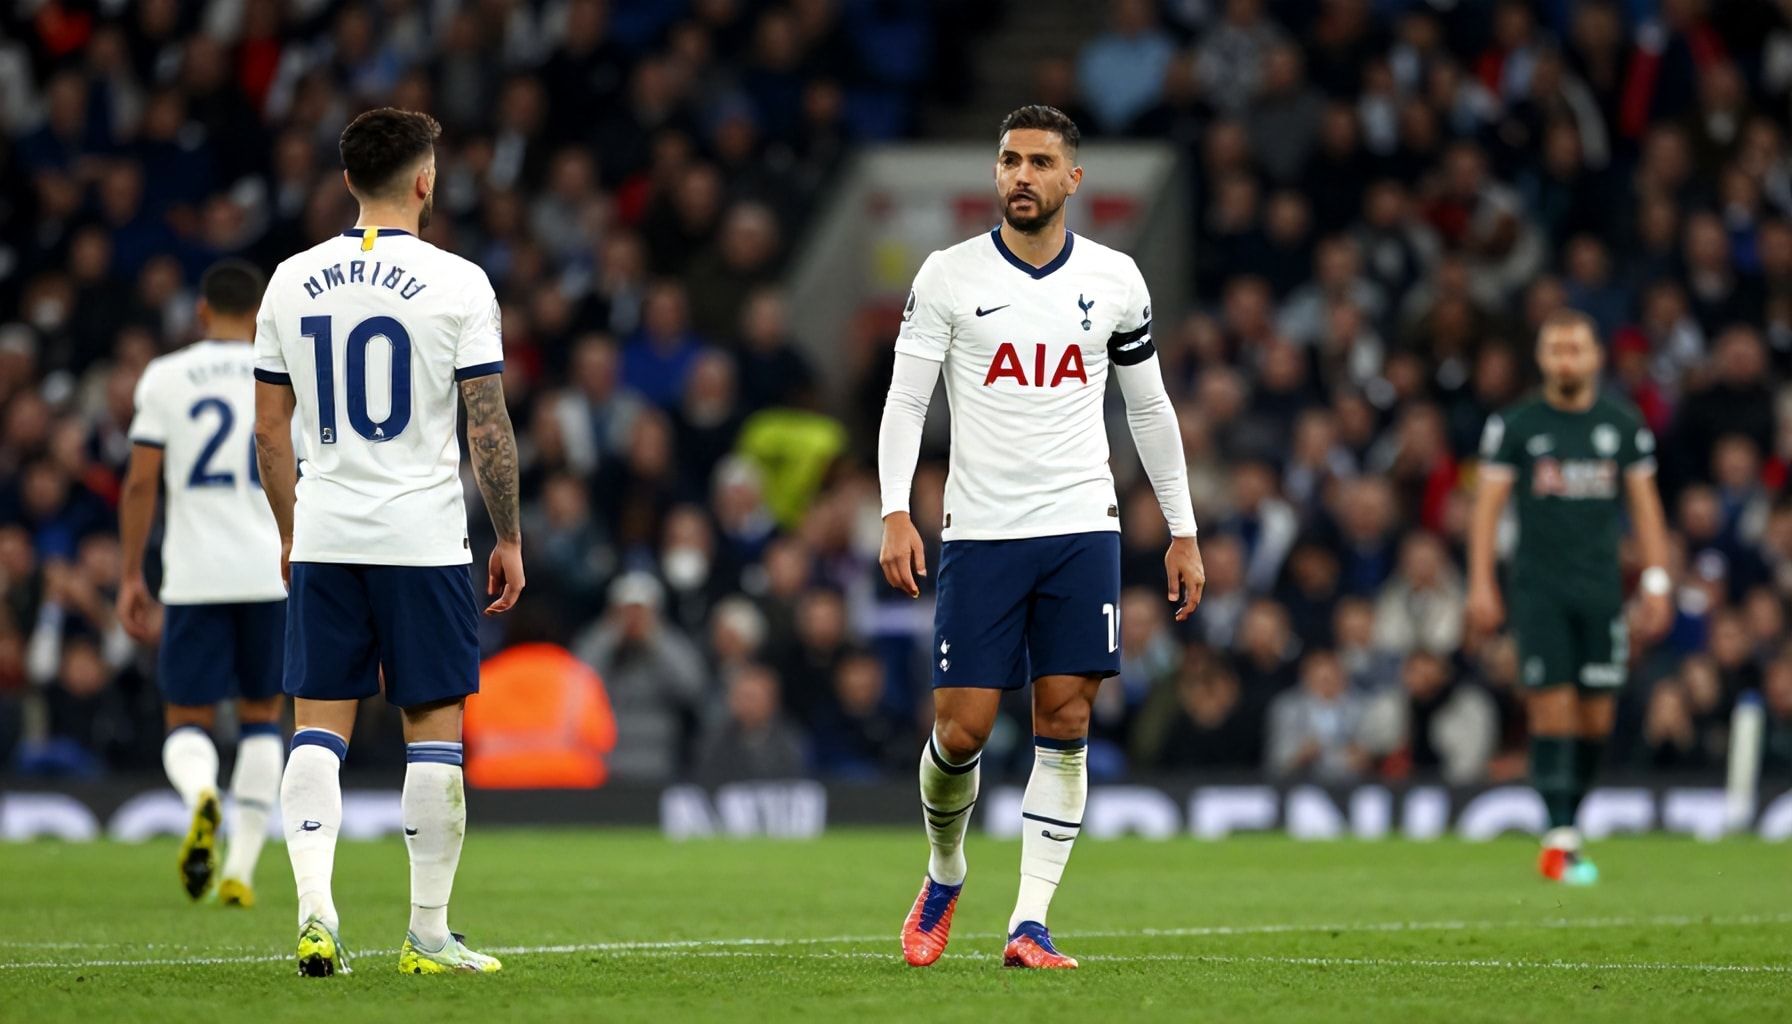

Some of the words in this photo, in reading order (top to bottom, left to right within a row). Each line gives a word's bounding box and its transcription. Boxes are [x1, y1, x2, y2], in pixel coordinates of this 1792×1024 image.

[300, 315, 412, 444] 10
[983, 342, 1087, 388] AIA
[186, 396, 262, 490] 2
